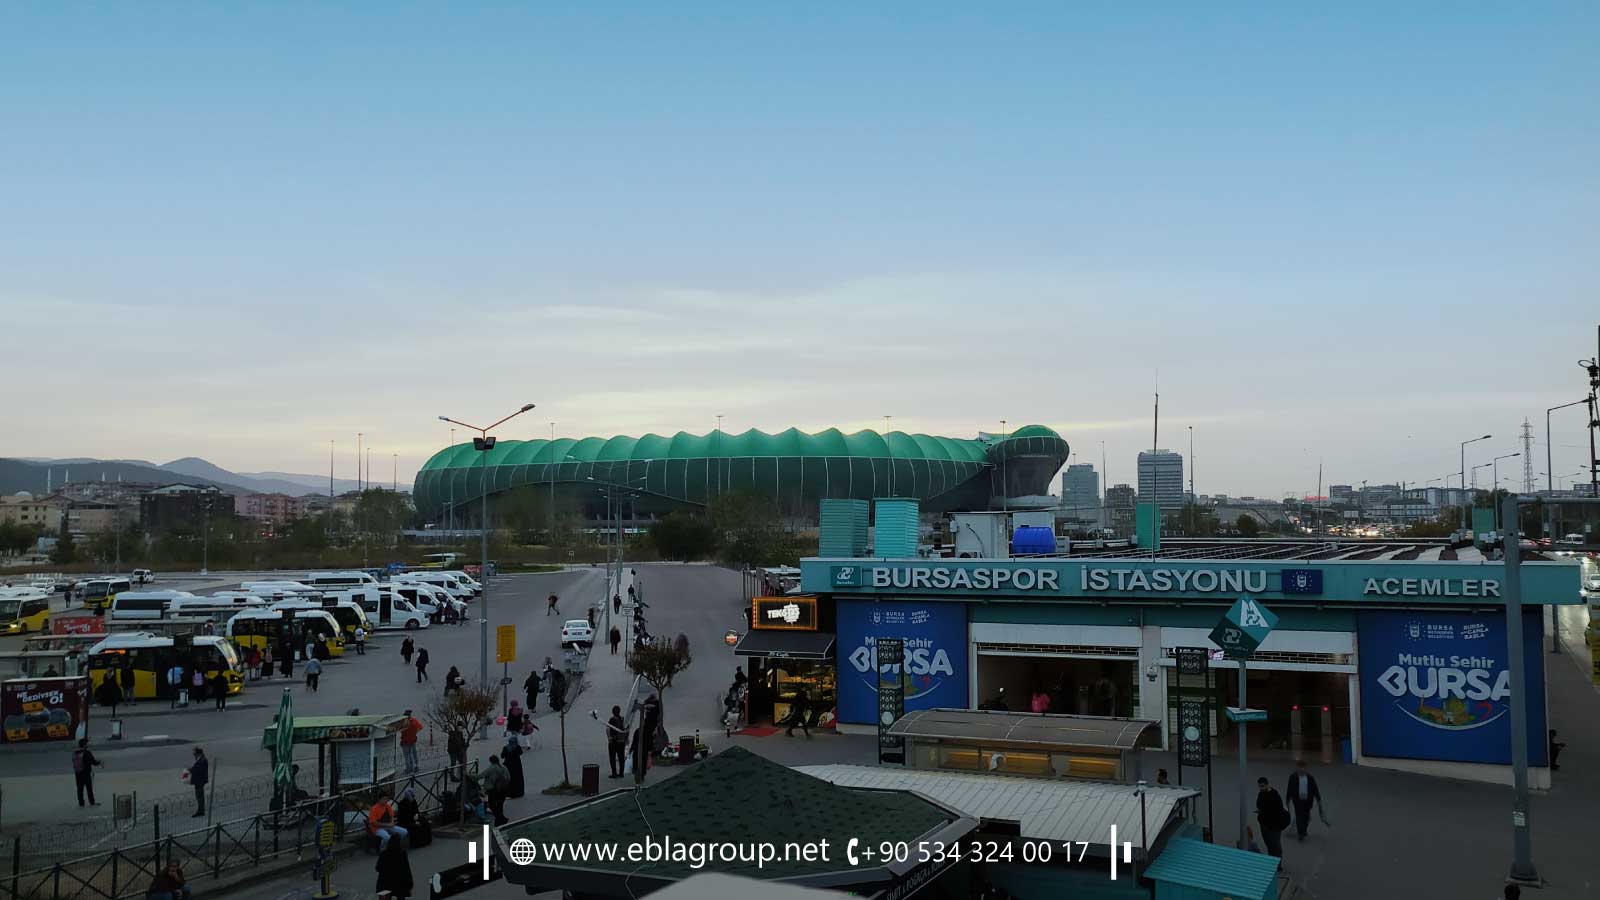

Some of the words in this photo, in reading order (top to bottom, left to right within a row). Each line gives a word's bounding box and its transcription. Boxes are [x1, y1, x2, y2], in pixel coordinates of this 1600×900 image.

[872, 567, 1059, 590] BURSASPOR
[1082, 564, 1267, 592] İSTASYONU
[1363, 577, 1501, 597] ACEMLER
[1398, 653, 1445, 667] Mutlu
[1377, 665, 1511, 701] BURSA
